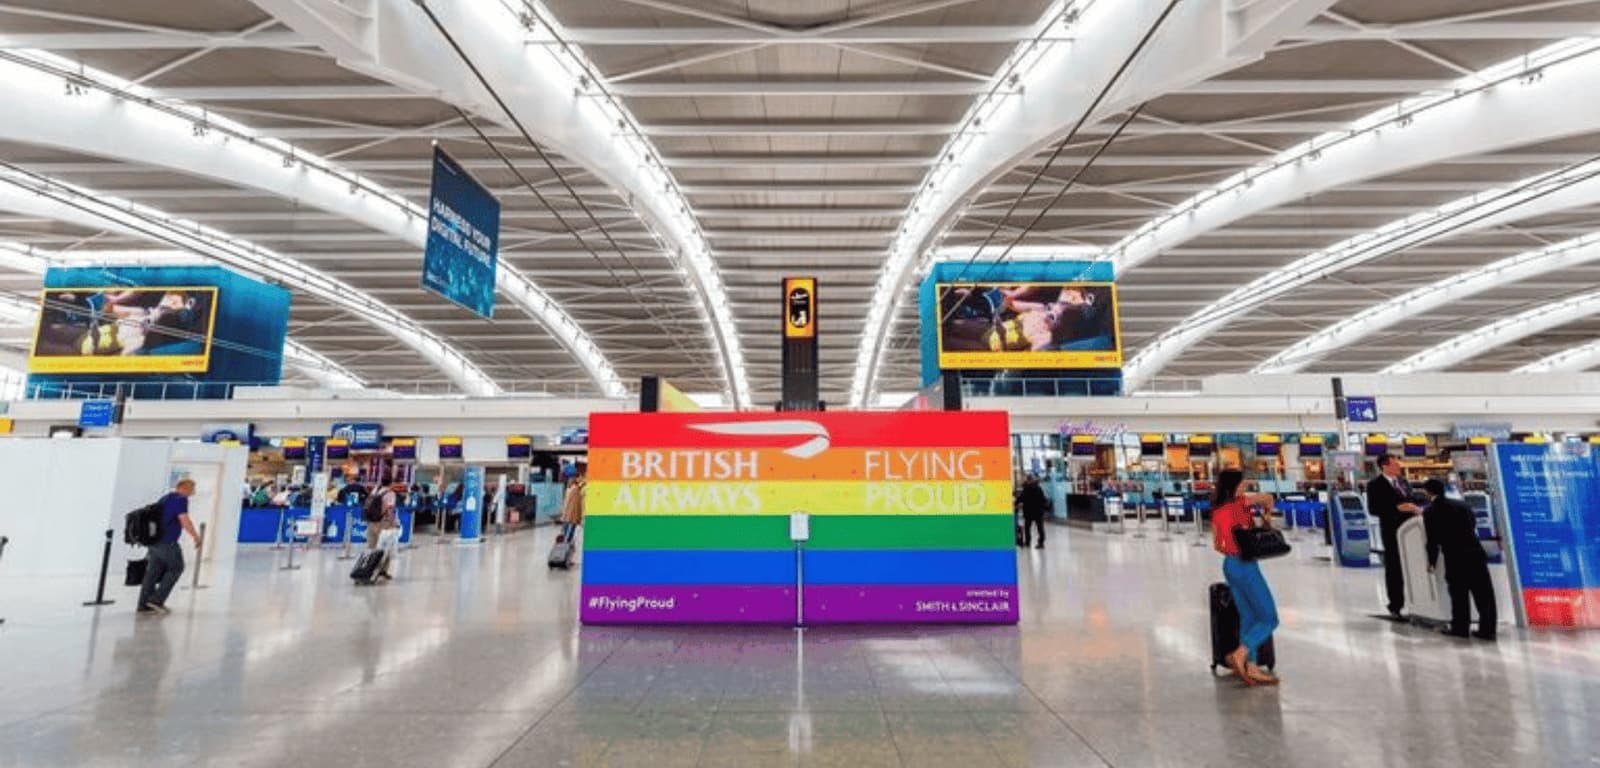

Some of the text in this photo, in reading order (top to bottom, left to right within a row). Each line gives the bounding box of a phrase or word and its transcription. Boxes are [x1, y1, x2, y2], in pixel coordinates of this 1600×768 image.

[621, 451, 759, 479] BRITISH
[864, 450, 984, 480] FLYING
[612, 483, 763, 512] AIRWAYS
[864, 482, 986, 513] PROUD
[588, 595, 675, 613] #FlyingProud
[915, 601, 949, 612] SMITH
[958, 601, 1009, 612] SINCLAIR
[966, 589, 1009, 600] created by
